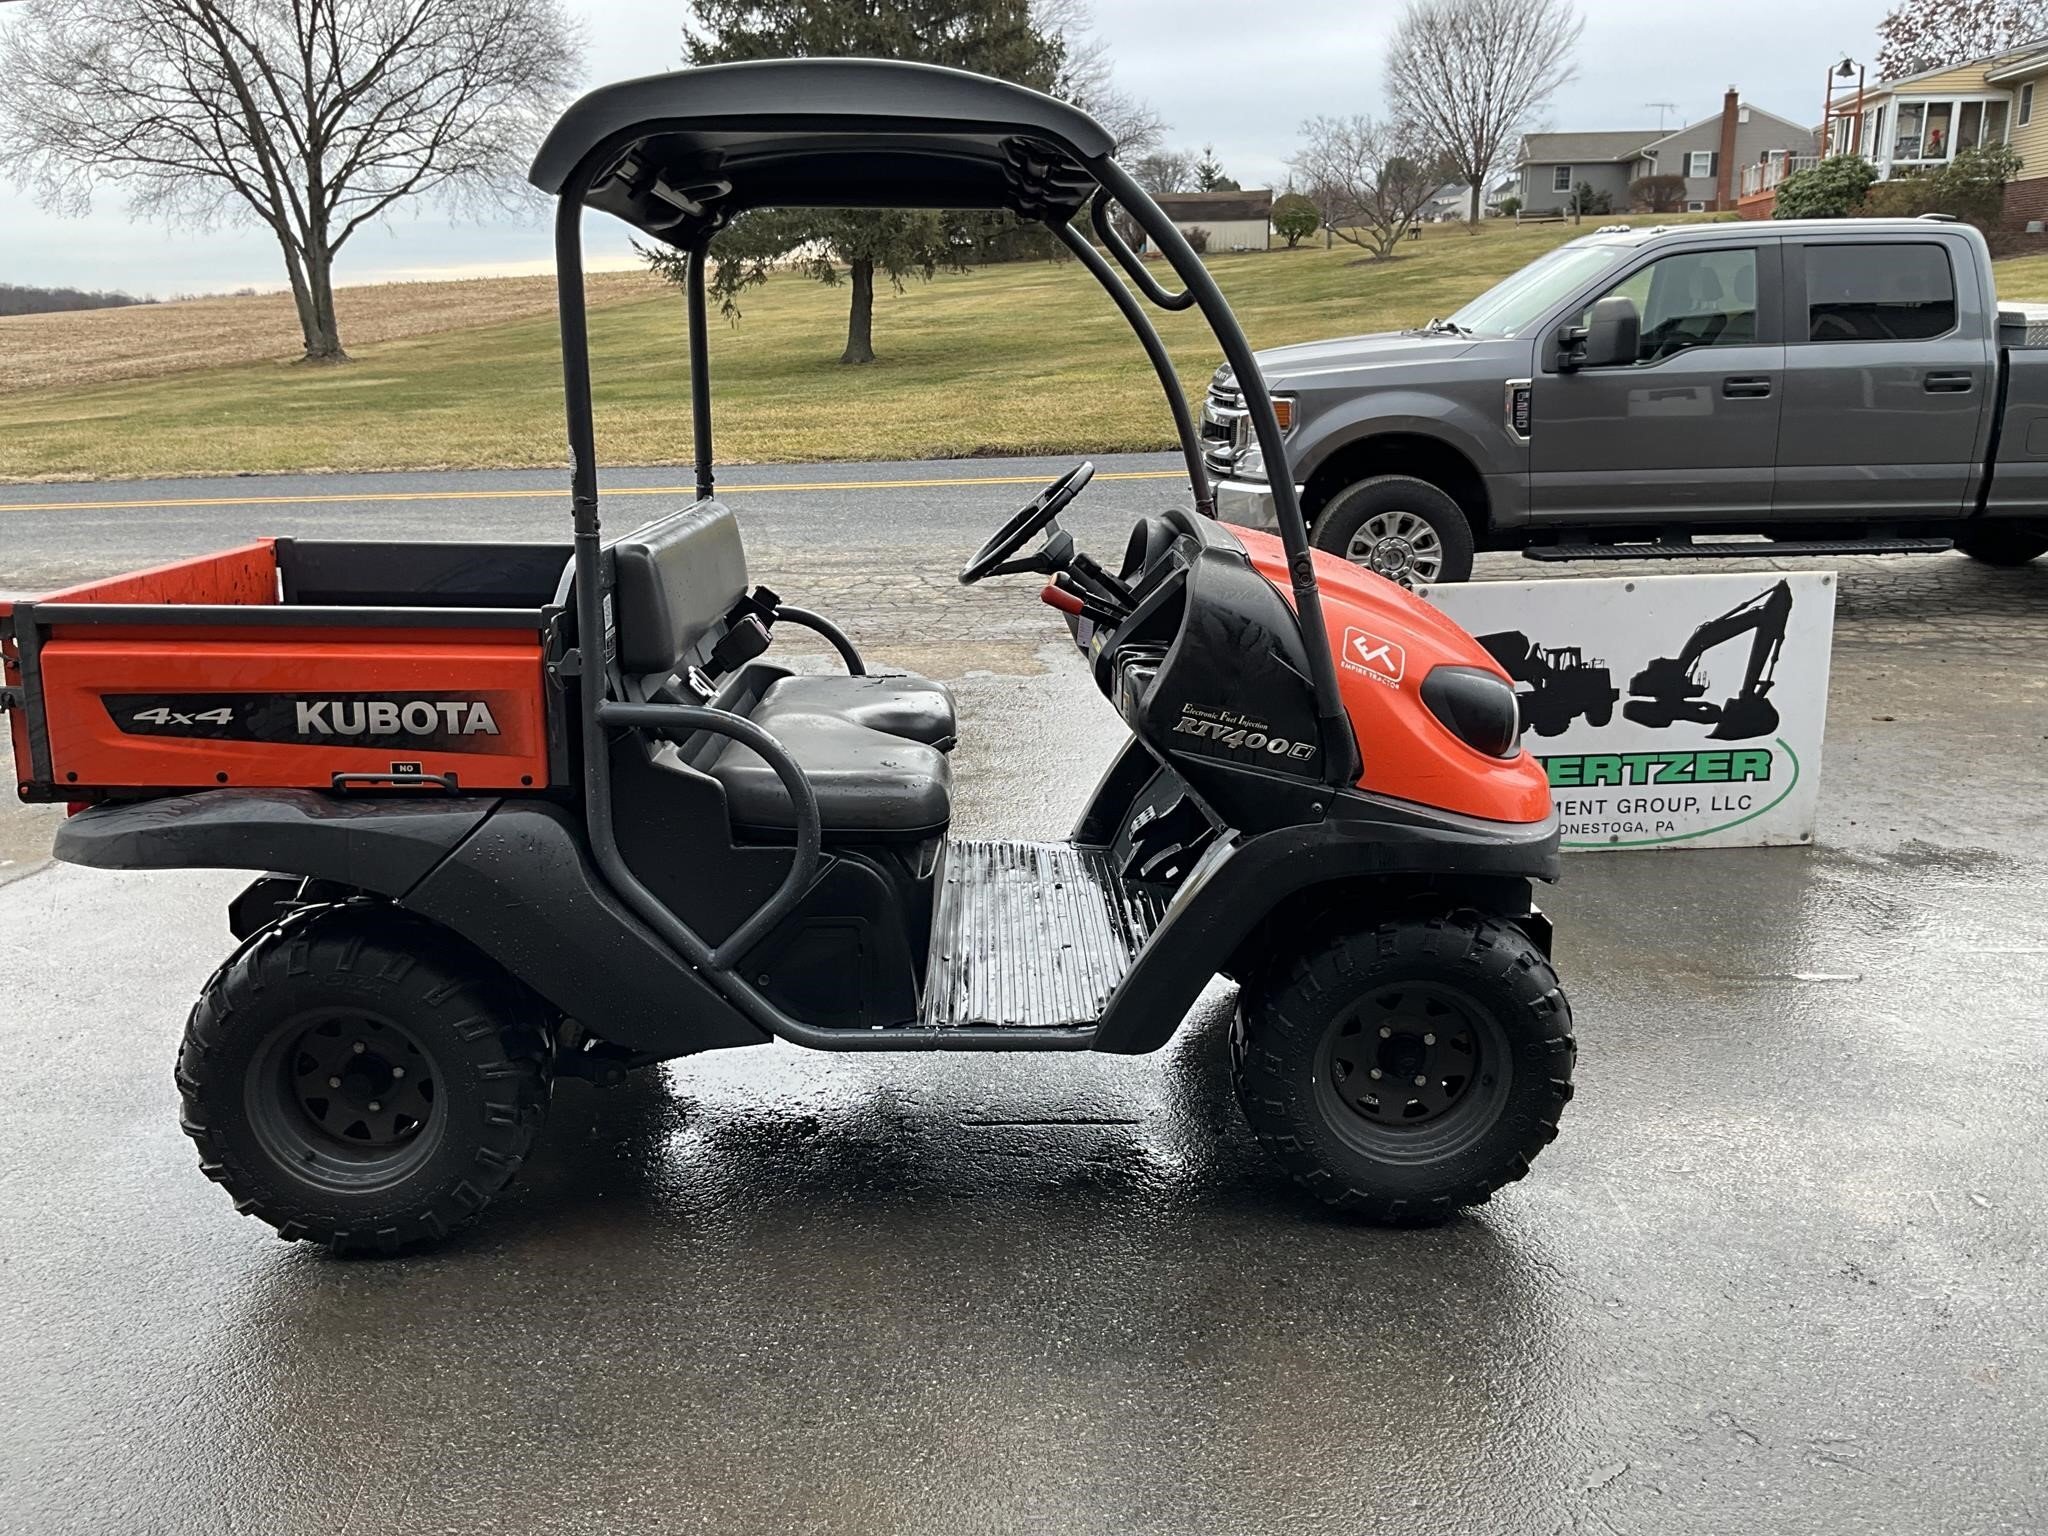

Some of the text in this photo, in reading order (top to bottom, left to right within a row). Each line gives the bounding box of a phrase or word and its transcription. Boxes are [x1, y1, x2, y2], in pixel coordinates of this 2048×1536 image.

[1340, 660, 1400, 690] EMPIRE TRACTOR
[132, 701, 500, 736] 4x4 KUBOTA
[1182, 703, 1268, 730] Electronic Fuel Injection
[399, 765, 414, 773] NO
[1534, 750, 1773, 788] ERTZER
[1616, 796, 1701, 814] GROUP,
[1711, 794, 1753, 811] LLC
[1655, 820, 1675, 832] PA
